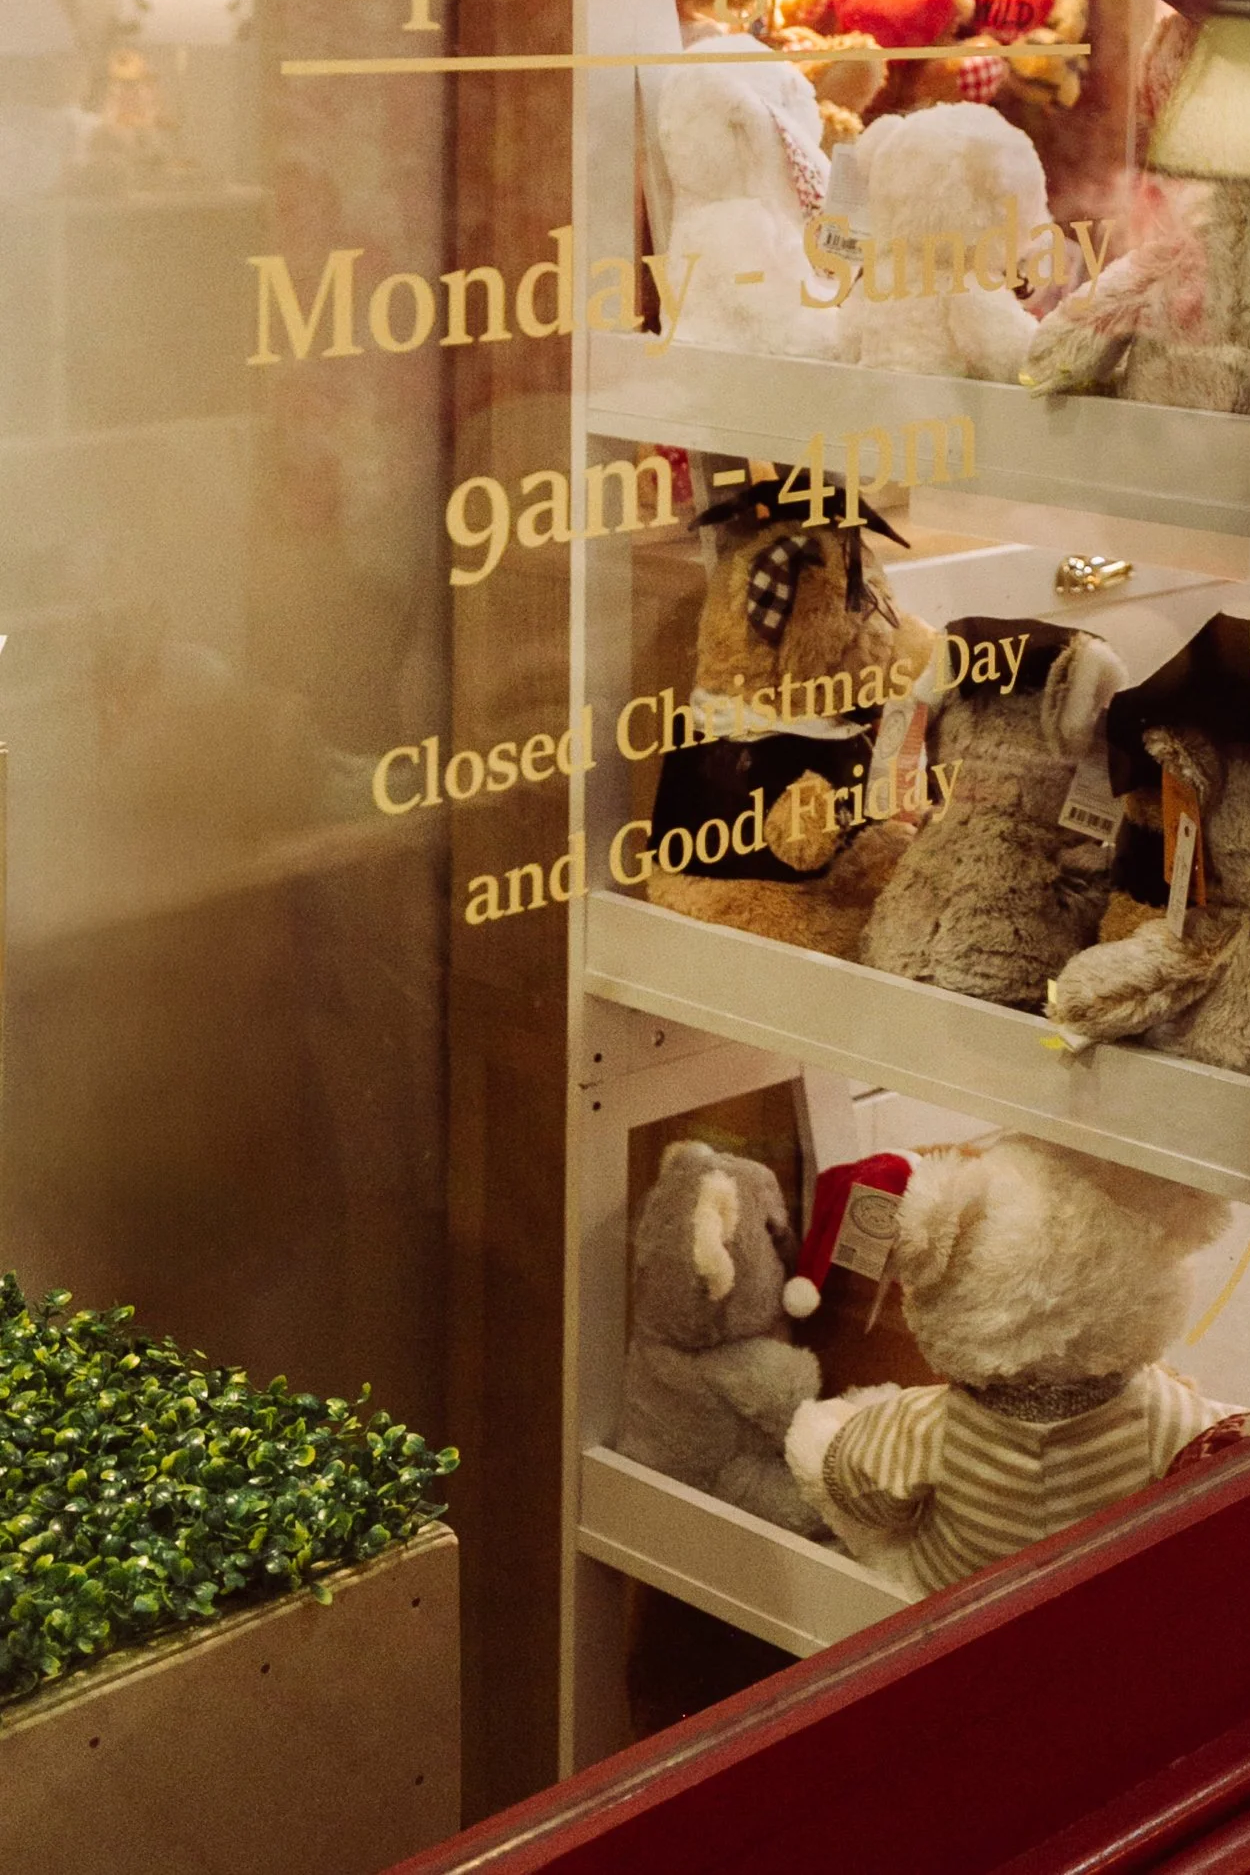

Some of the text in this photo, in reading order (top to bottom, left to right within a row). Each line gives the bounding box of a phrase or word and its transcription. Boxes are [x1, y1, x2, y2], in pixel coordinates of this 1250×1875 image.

[246, 194, 1117, 367] Monday - Sunday
[445, 414, 978, 587] 9am - 4pm
[371, 629, 1030, 814] Closed Christmas Day
[464, 830, 589, 927] and
[609, 787, 771, 886] Good
[786, 758, 965, 845] Friday
